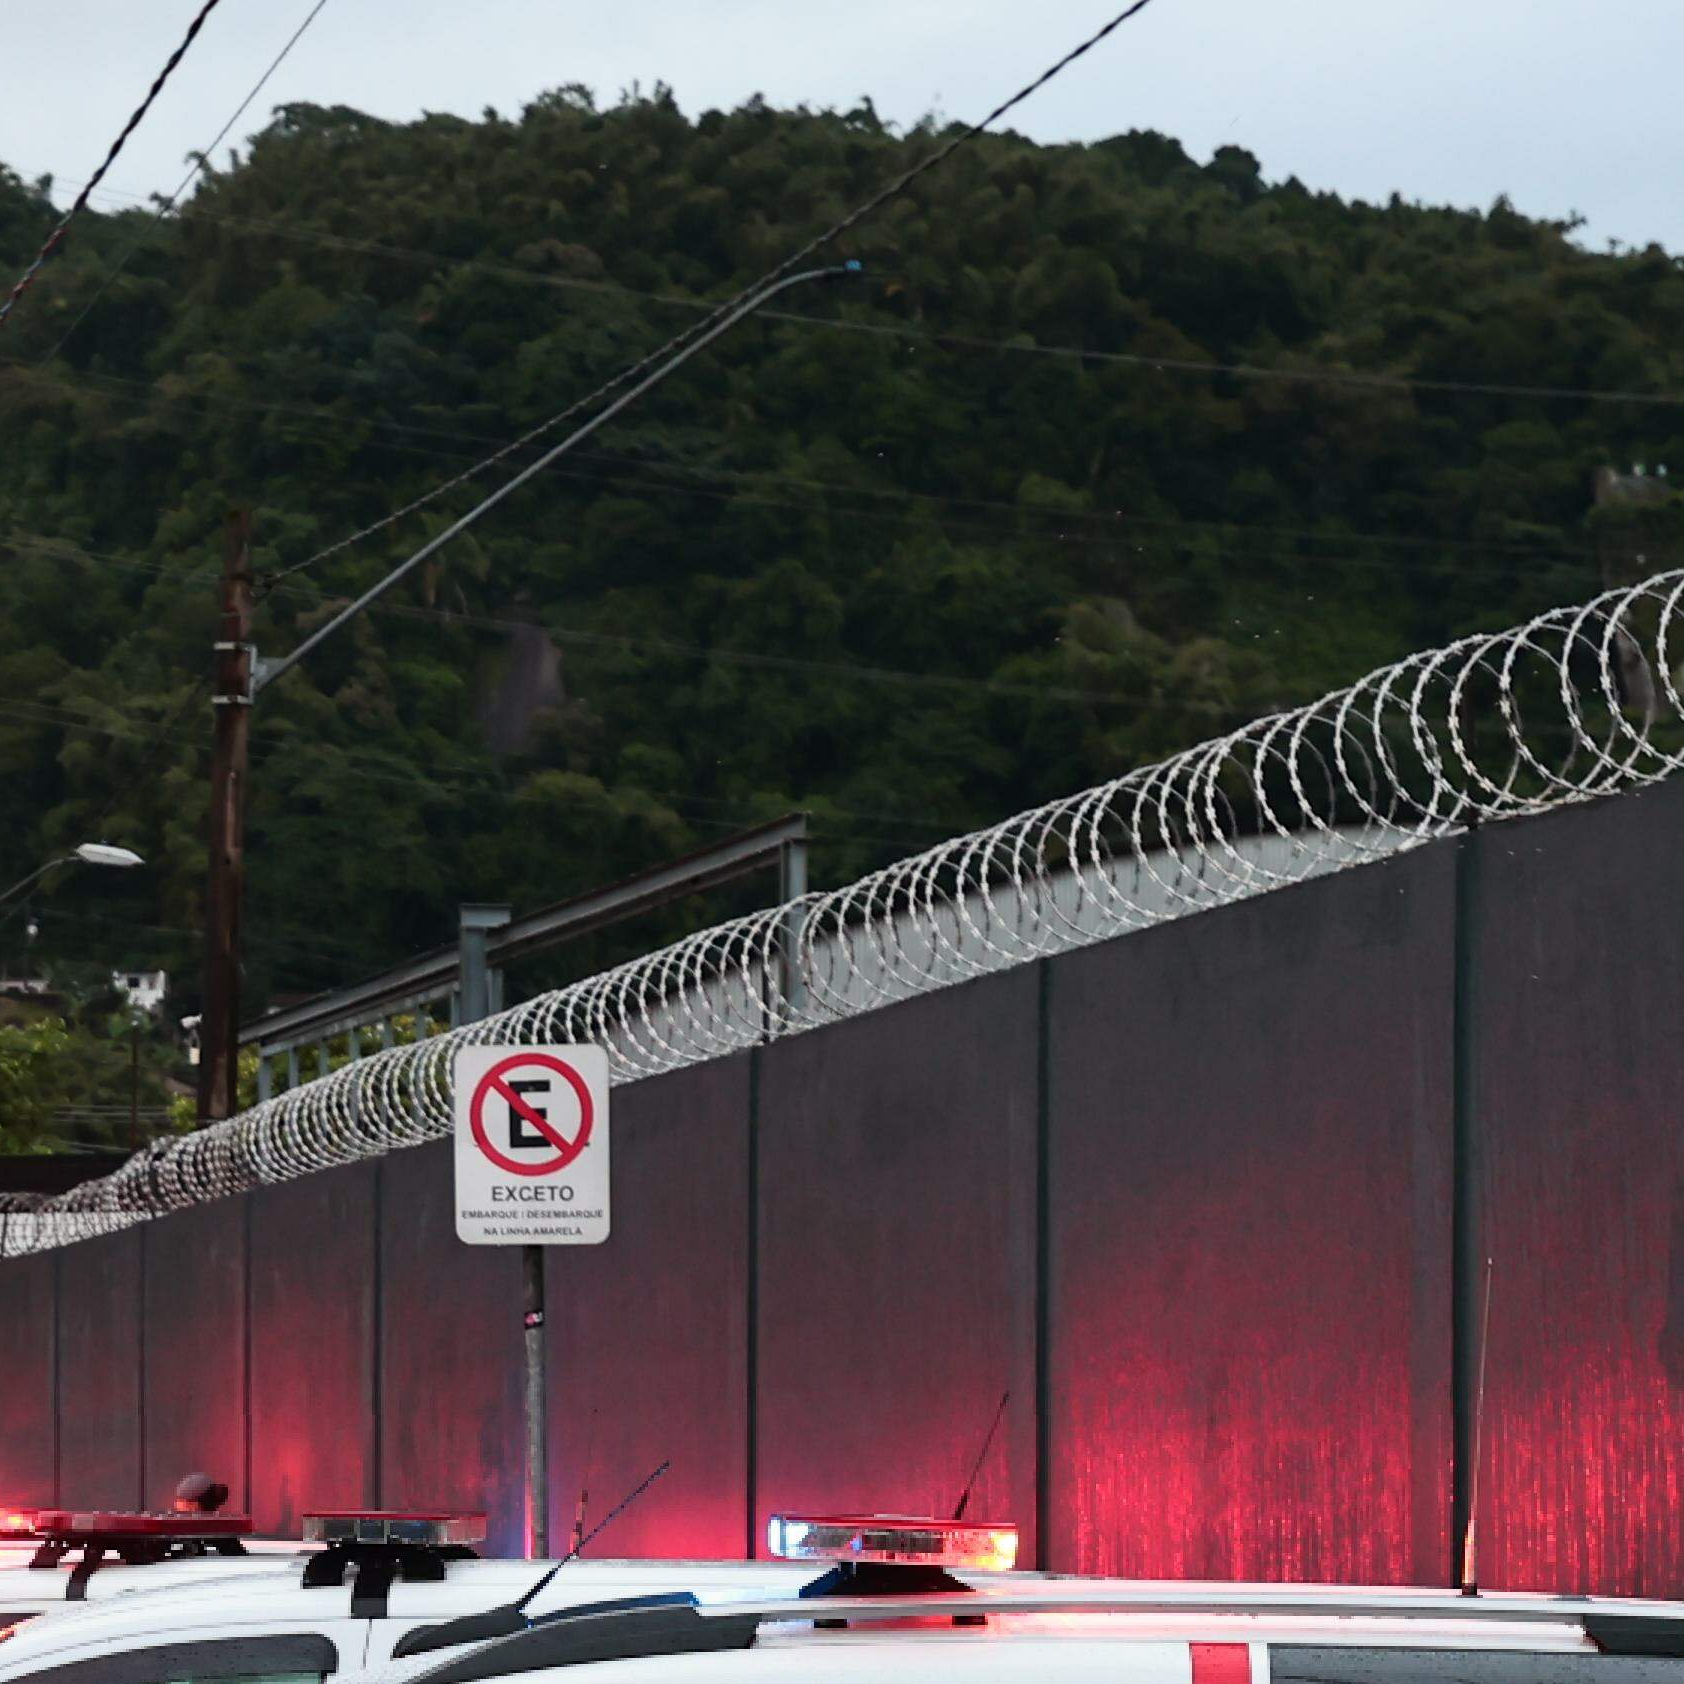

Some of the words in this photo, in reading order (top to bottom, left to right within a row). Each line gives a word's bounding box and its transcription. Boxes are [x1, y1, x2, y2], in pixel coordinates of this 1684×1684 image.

[491, 1185, 575, 1202] EXCETO
[461, 1210, 517, 1219] EMBARQUE
[527, 1209, 604, 1218] DESEMBARQUE
[483, 1227, 498, 1235] NA
[500, 1227, 531, 1235] LINHA
[533, 1227, 582, 1235] AMARELA
